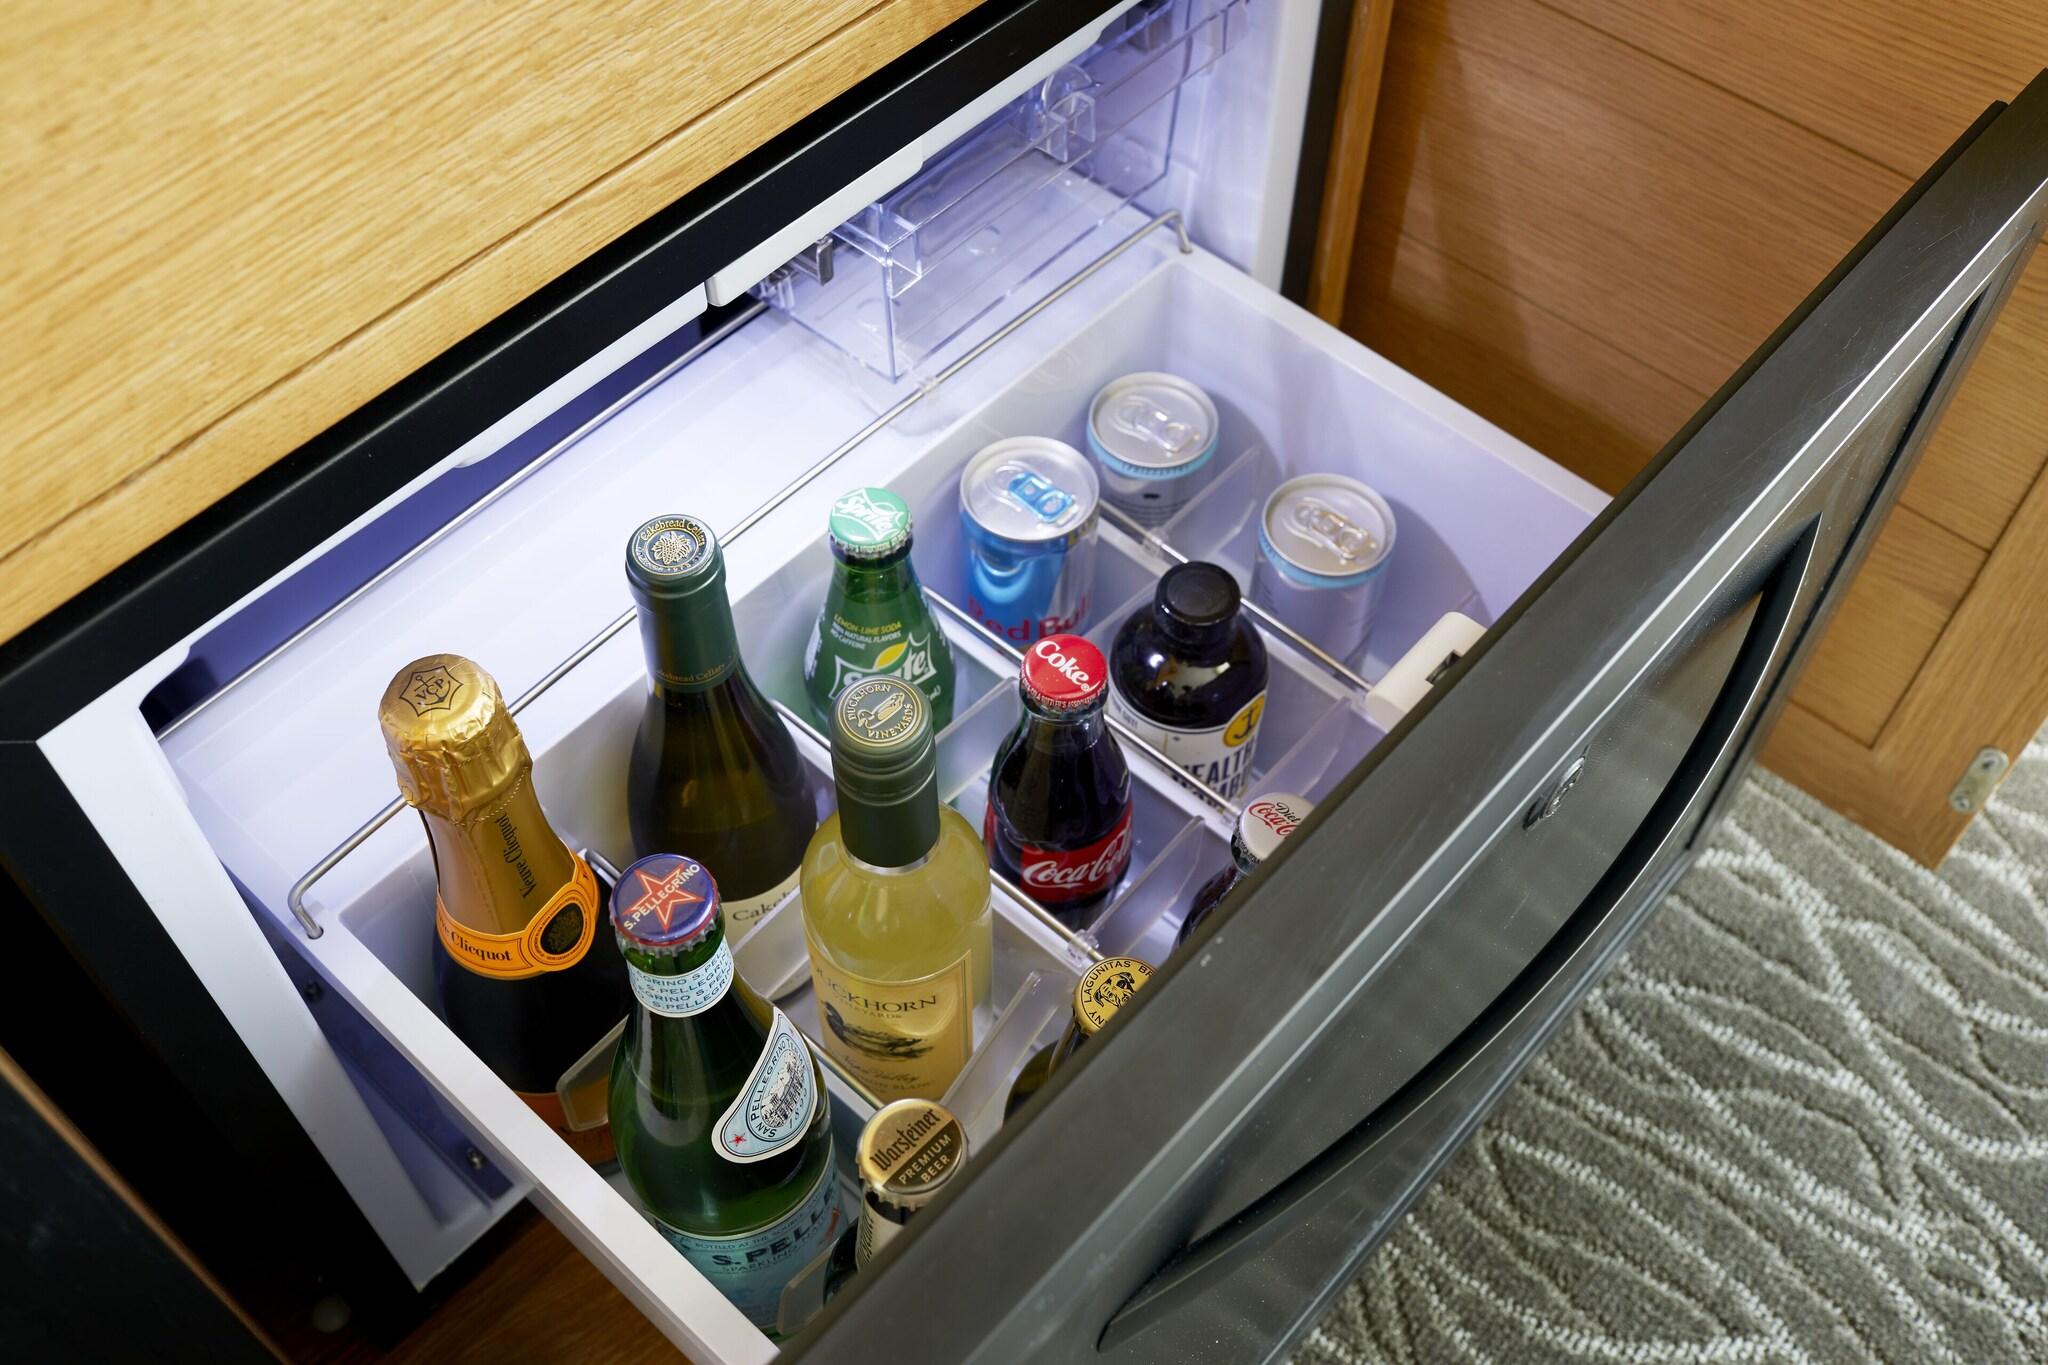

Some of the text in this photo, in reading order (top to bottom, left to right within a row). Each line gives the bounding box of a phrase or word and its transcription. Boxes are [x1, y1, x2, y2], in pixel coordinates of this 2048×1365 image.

[640, 518, 686, 541] Cakebread
[835, 496, 893, 531] Sprite
[1035, 640, 1089, 686] Coke
[416, 678, 444, 700] VCP
[847, 684, 892, 721] DUCKHORN
[868, 703, 914, 739] VINEYARDS
[1276, 802, 1301, 823] Diet
[494, 813, 538, 899] Veuve Clicquot
[623, 863, 701, 931] S.PELLEGRINO
[452, 932, 513, 961] Clicquot
[1083, 960, 1132, 1003] LAGUNITAS
[750, 1041, 786, 1139] SAN PELLEGRINO
[869, 1108, 941, 1171] Warsteiner
[898, 1134, 952, 1185] PREMIUM
[920, 1154, 951, 1184] BEER
